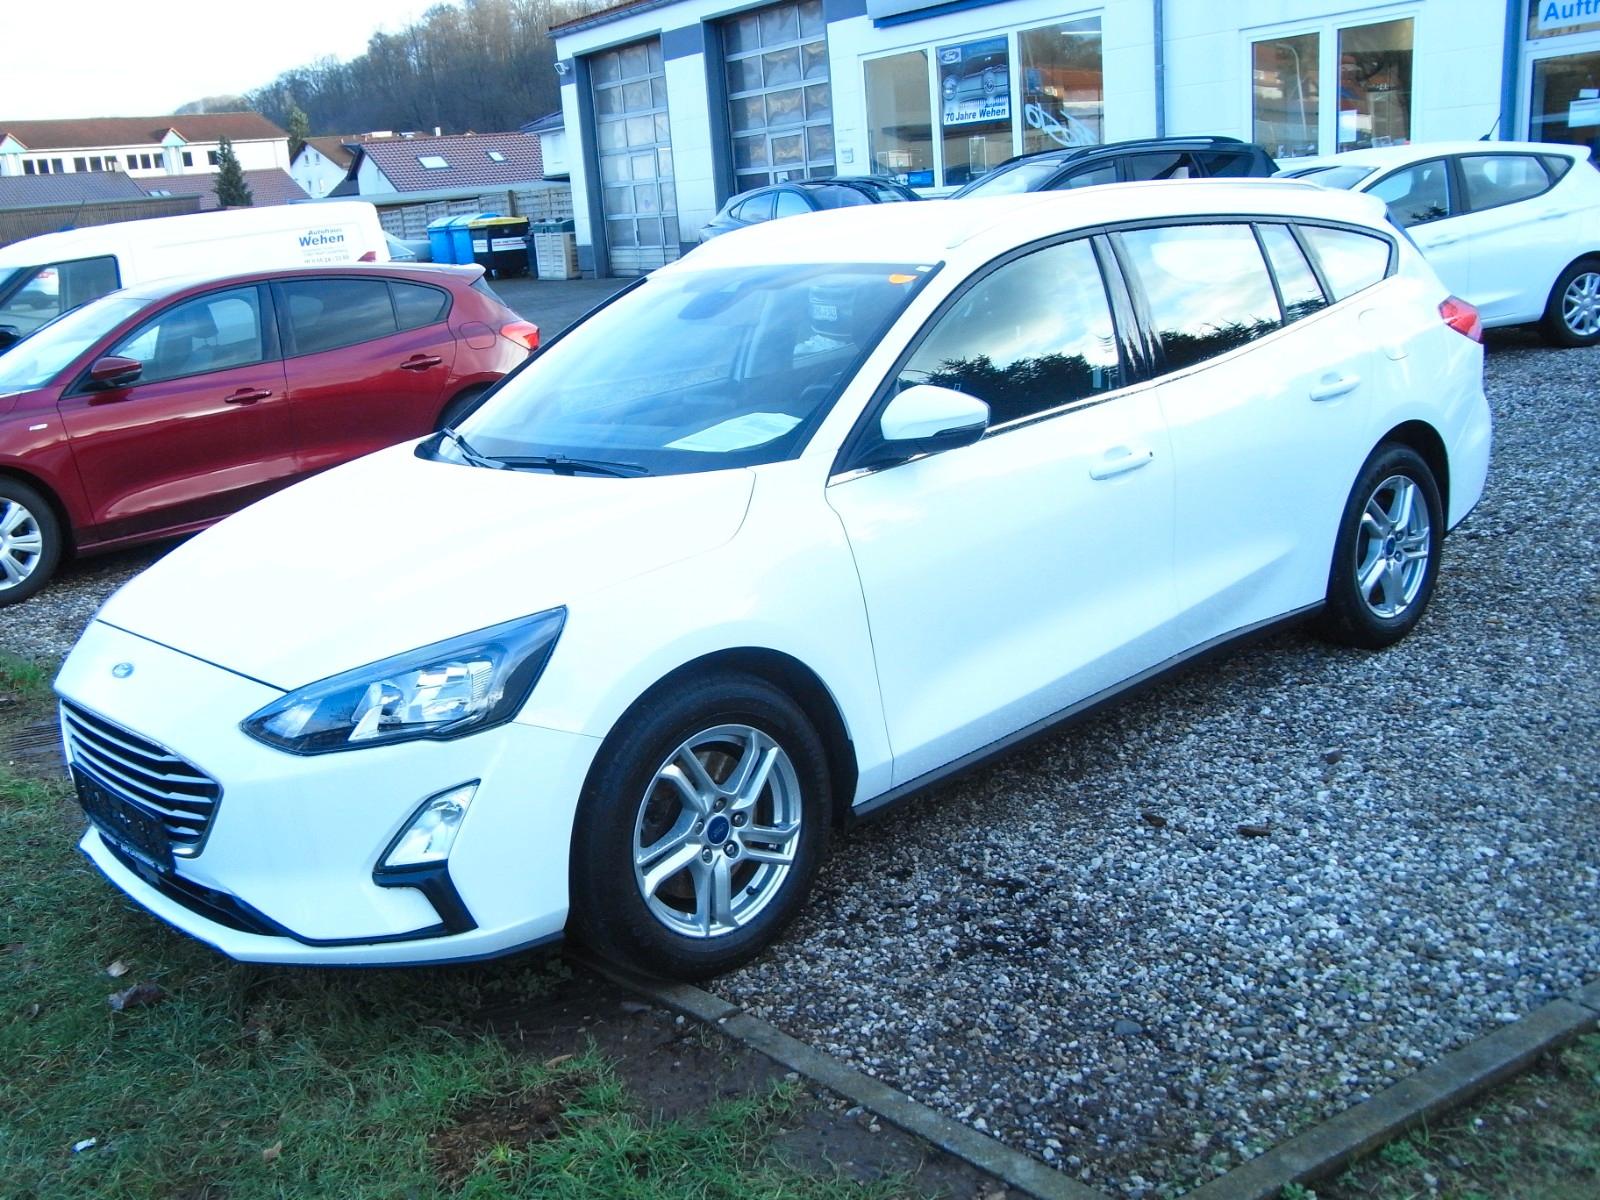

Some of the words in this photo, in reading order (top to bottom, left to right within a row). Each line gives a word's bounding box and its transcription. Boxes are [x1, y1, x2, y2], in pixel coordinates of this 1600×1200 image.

[945, 112, 955, 122] 70
[956, 111, 977, 121] Jahre
[980, 107, 1006, 118] Wehen
[299, 234, 344, 247] Wehen
